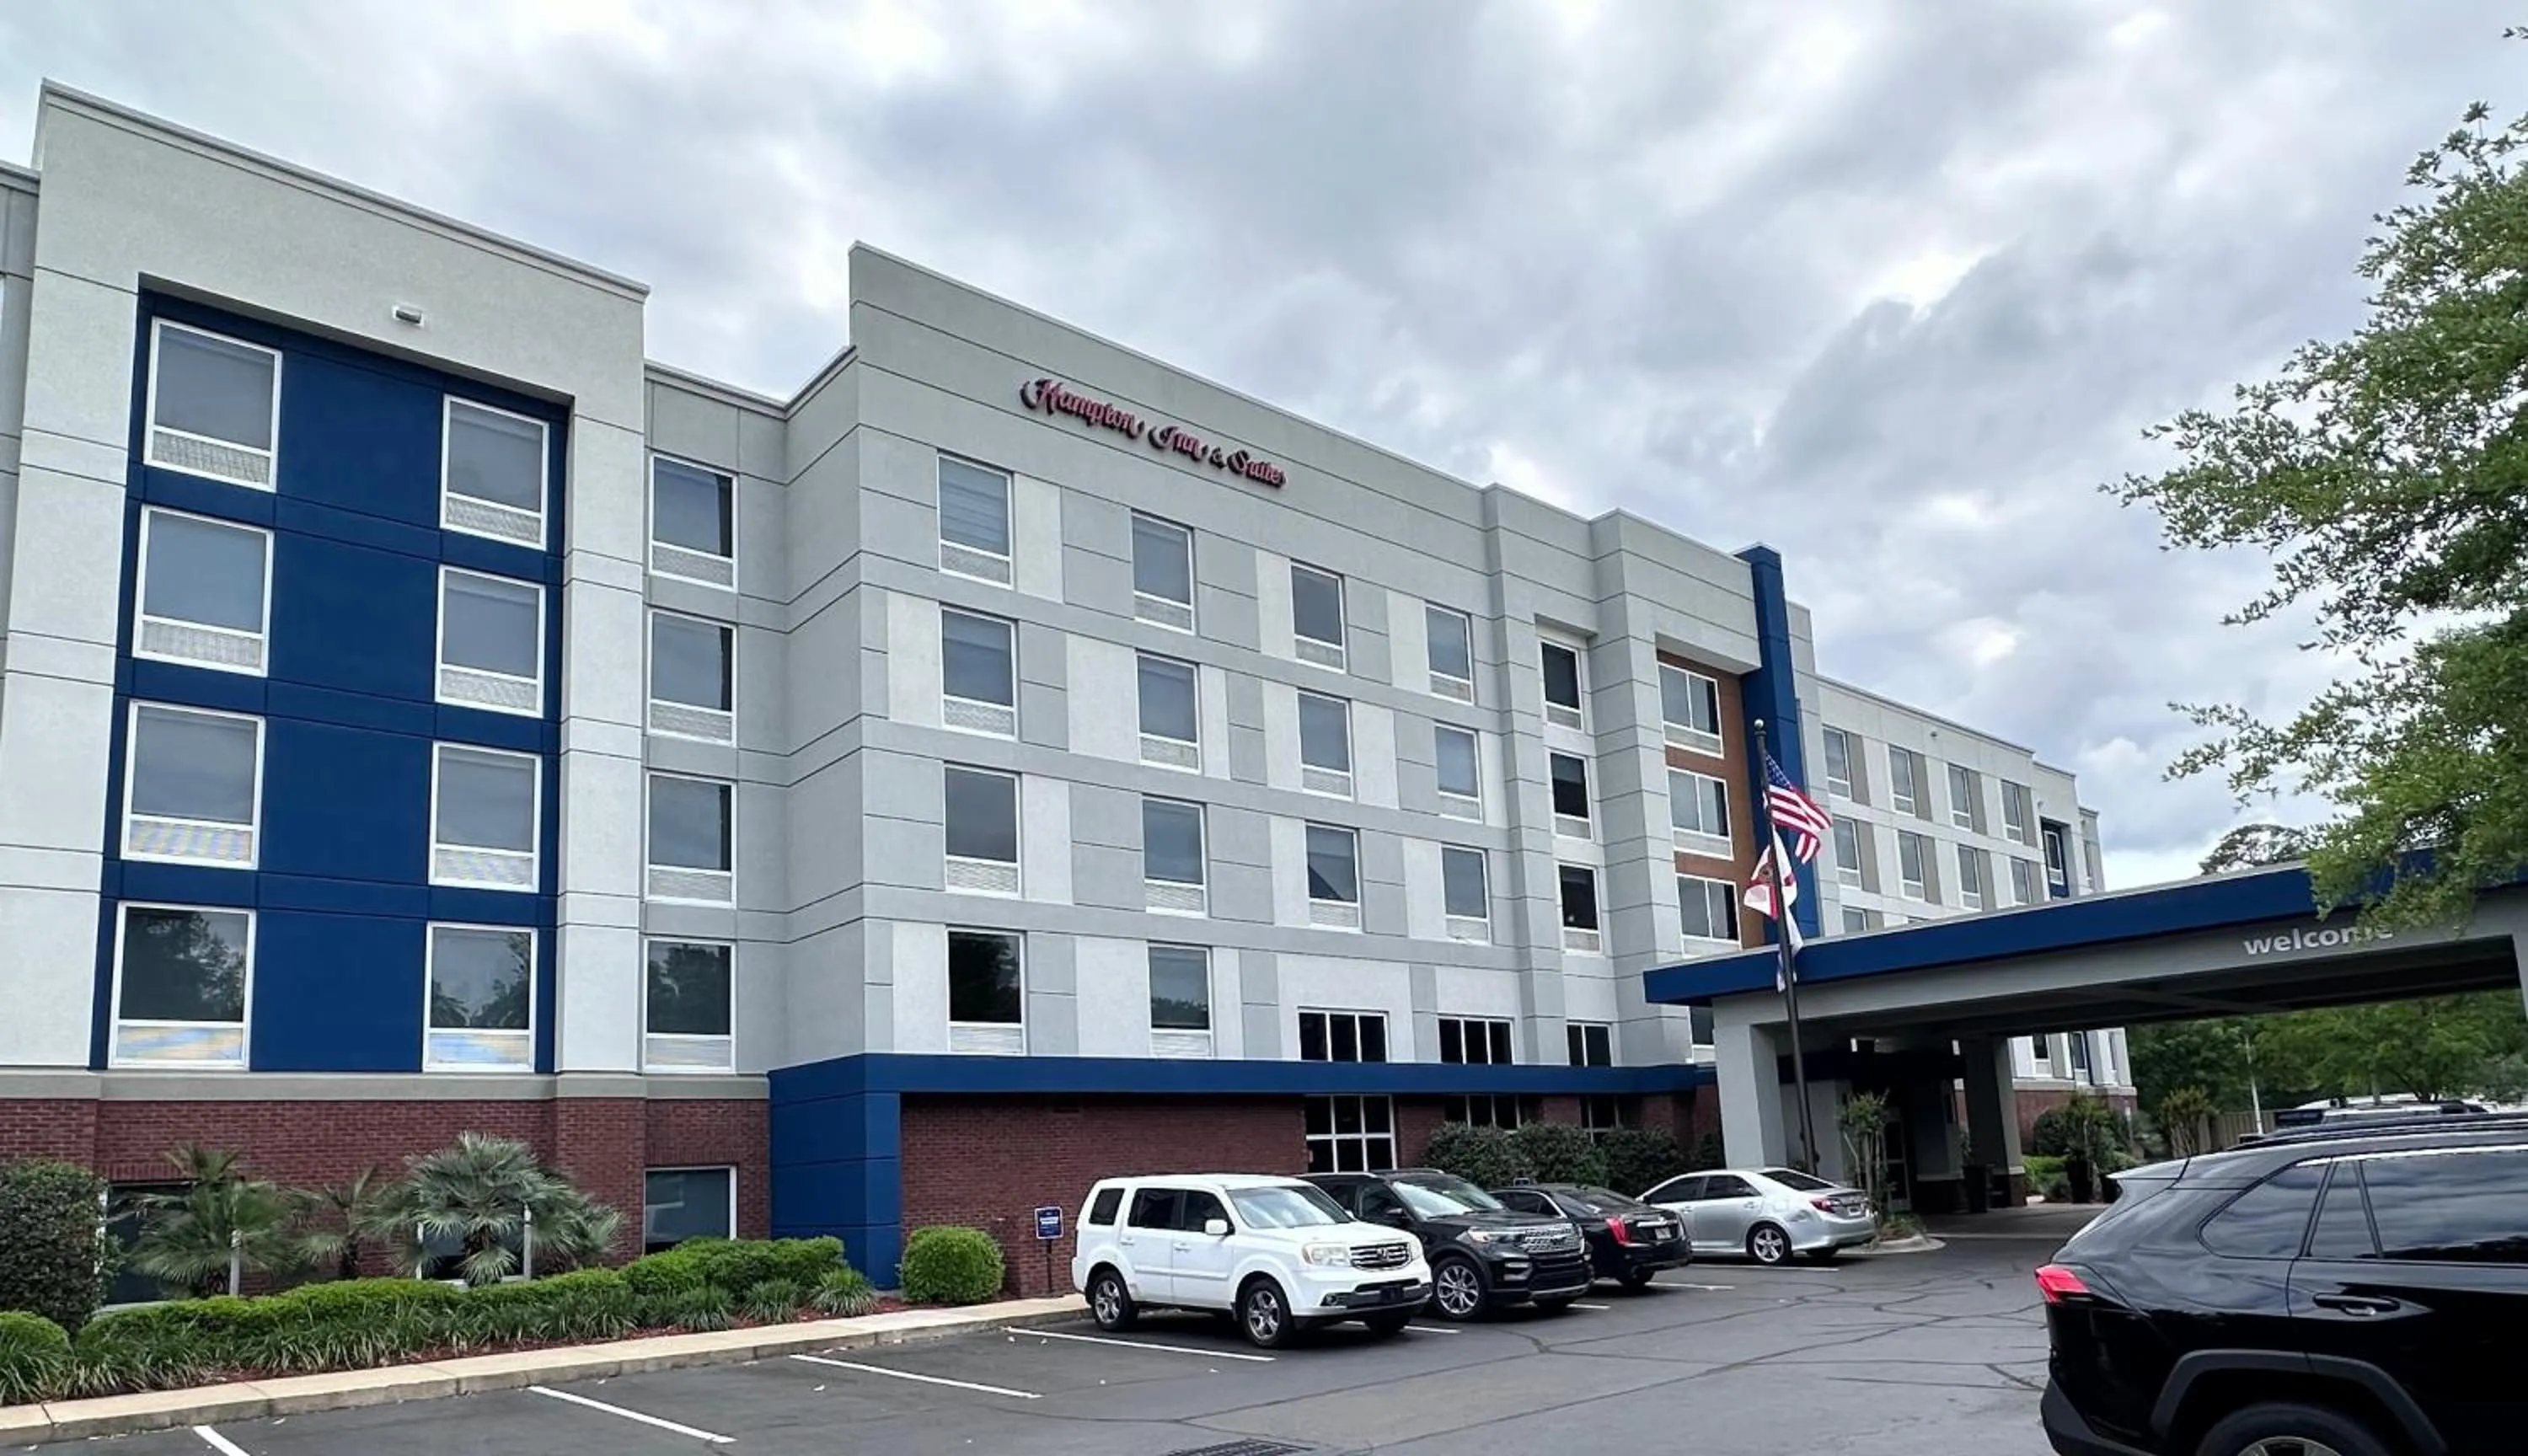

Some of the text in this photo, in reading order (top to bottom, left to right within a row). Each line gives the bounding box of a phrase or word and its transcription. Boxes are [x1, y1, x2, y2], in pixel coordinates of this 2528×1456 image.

[1020, 378, 1287, 488] Hampton Inn & Suites
